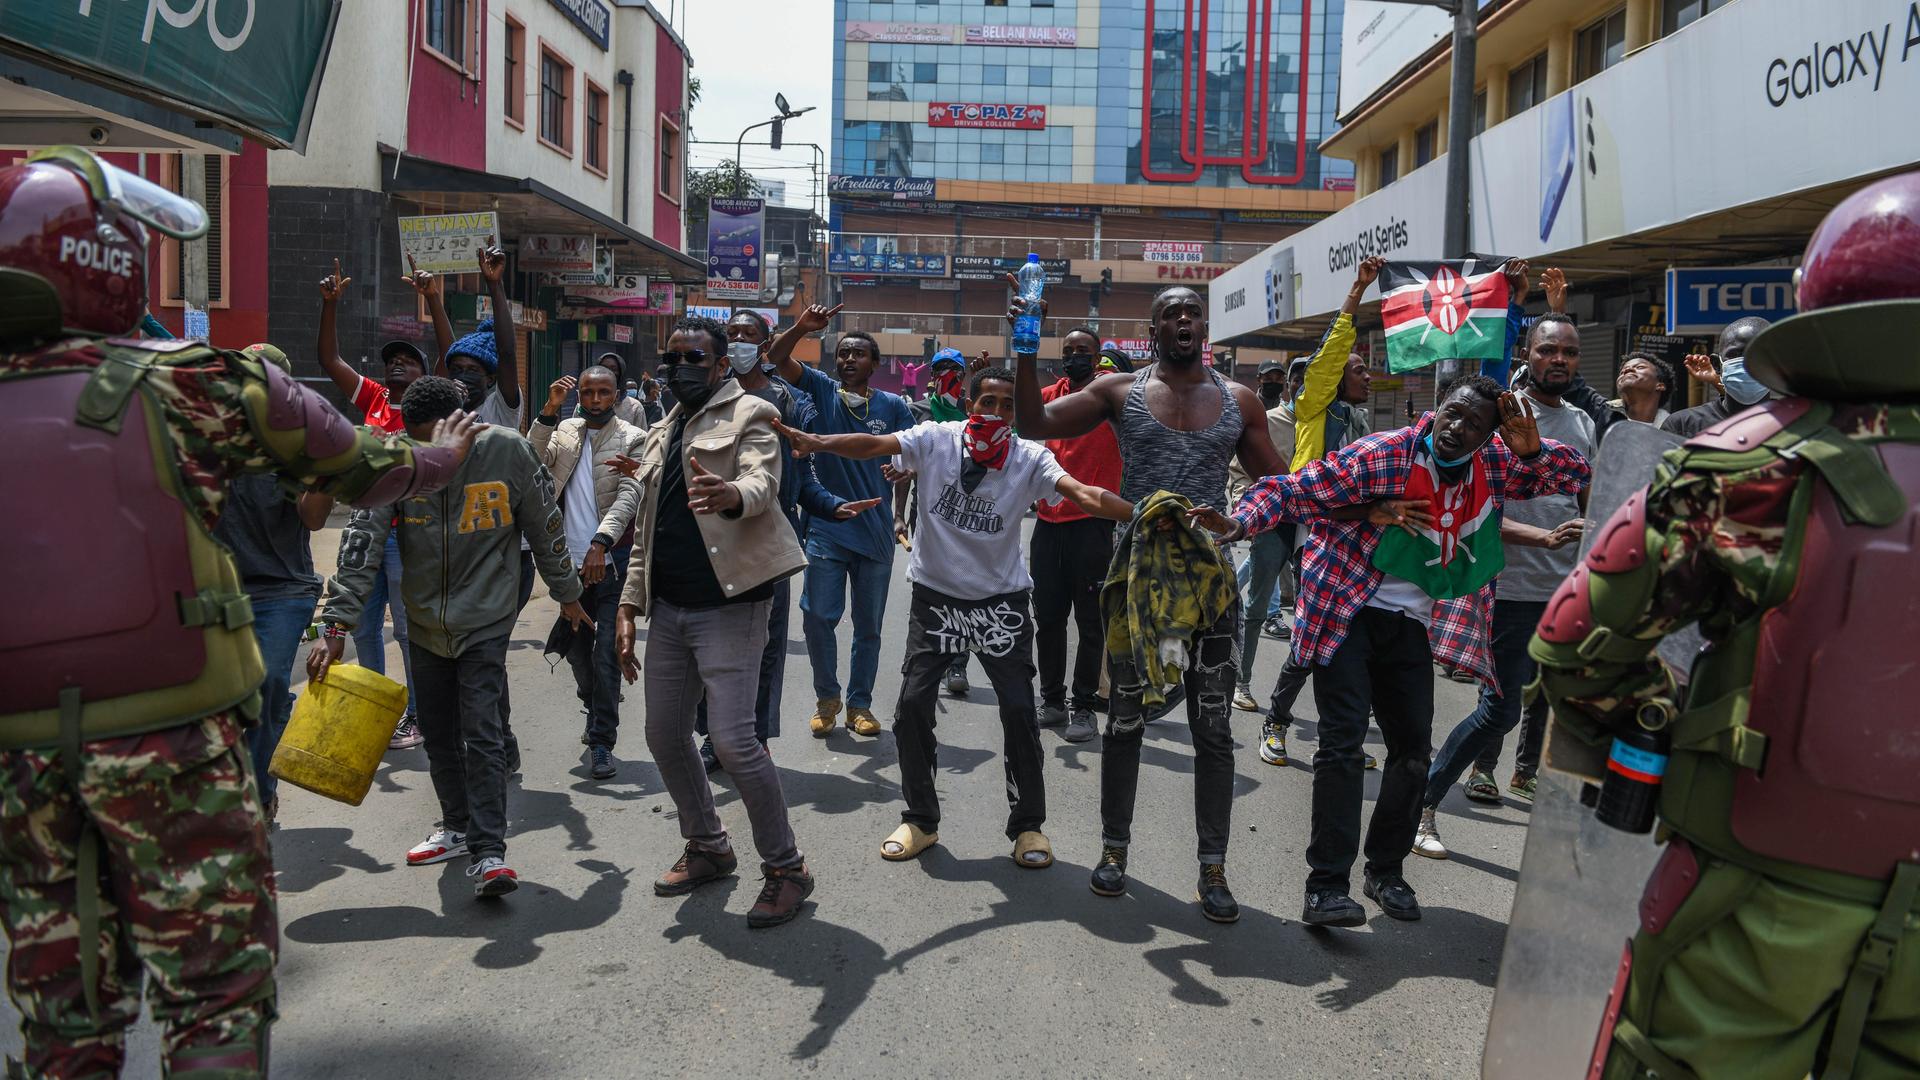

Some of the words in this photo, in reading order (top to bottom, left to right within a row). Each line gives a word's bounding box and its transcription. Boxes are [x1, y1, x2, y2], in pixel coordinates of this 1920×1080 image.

[581, 0, 606, 39] CENTRE
[983, 25, 1025, 38] BELLANI
[1029, 27, 1052, 39] NAIL
[1056, 27, 1075, 40] SPA
[1766, 23, 1891, 107] Galaxy
[947, 104, 1027, 120] TOPAZ
[894, 178, 935, 195] Beauty
[401, 214, 493, 233] NETWAVE
[1240, 211, 1281, 219] SUPERIOR
[1145, 243, 1173, 251] SPACE
[1187, 244, 1202, 252] LET
[1329, 239, 1357, 273] Galaxy
[1358, 229, 1375, 261] S24
[1376, 216, 1408, 255] Series
[60, 236, 132, 278] POLICE
[955, 257, 991, 265] DENFA
[1151, 252, 1169, 260] 0796
[1171, 252, 1185, 260] 558
[1186, 253, 1200, 261] 066
[1158, 265, 1233, 279] PLATIN
[614, 276, 637, 289] YS
[1225, 288, 1246, 313] SAMSUNG
[1690, 282, 1794, 311] TECN
[964, 494, 995, 517] the
